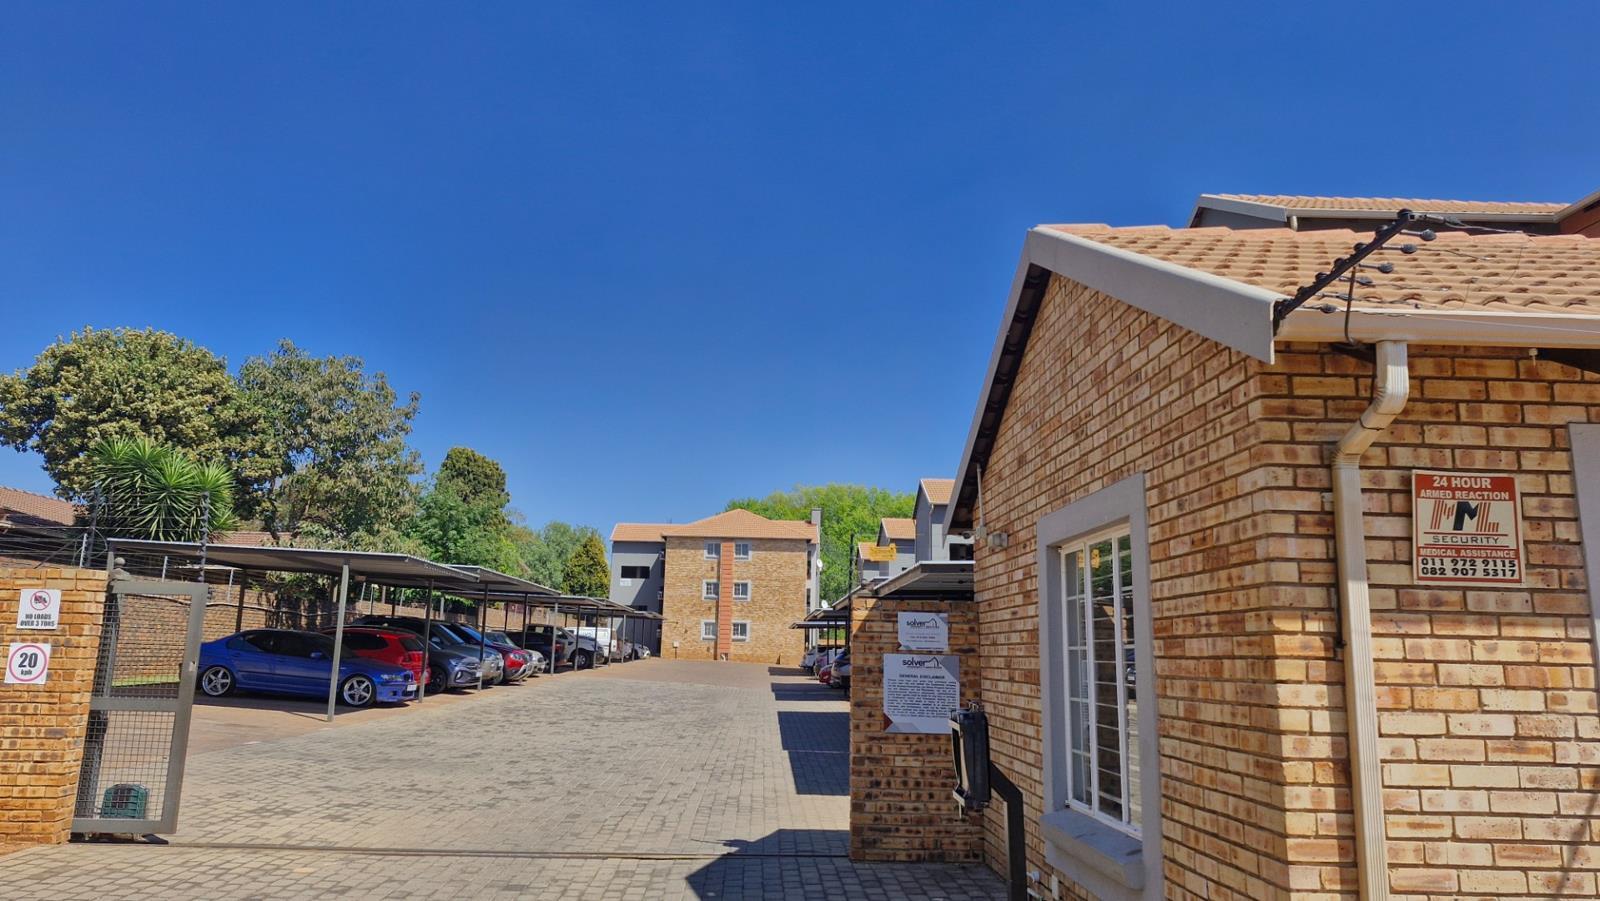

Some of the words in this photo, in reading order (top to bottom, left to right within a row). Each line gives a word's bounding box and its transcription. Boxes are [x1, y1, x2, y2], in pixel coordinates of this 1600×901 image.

[1433, 476, 1448, 487] 24
[1452, 477, 1492, 488] HOUR
[1420, 489, 1452, 499] ARMED
[1455, 491, 1509, 500] REACTION
[1433, 536, 1500, 544] SECURITY
[1420, 548, 1457, 557] MEDICAL
[1460, 550, 1516, 558] ASSISTANCE
[1421, 558, 1444, 566] 011
[1451, 559, 1476, 567] 972
[1482, 559, 1516, 568] 9115
[1421, 567, 1446, 576] 082
[1451, 568, 1477, 576] 907
[1483, 569, 1516, 577] 5317
[18, 652, 38, 668] 20
